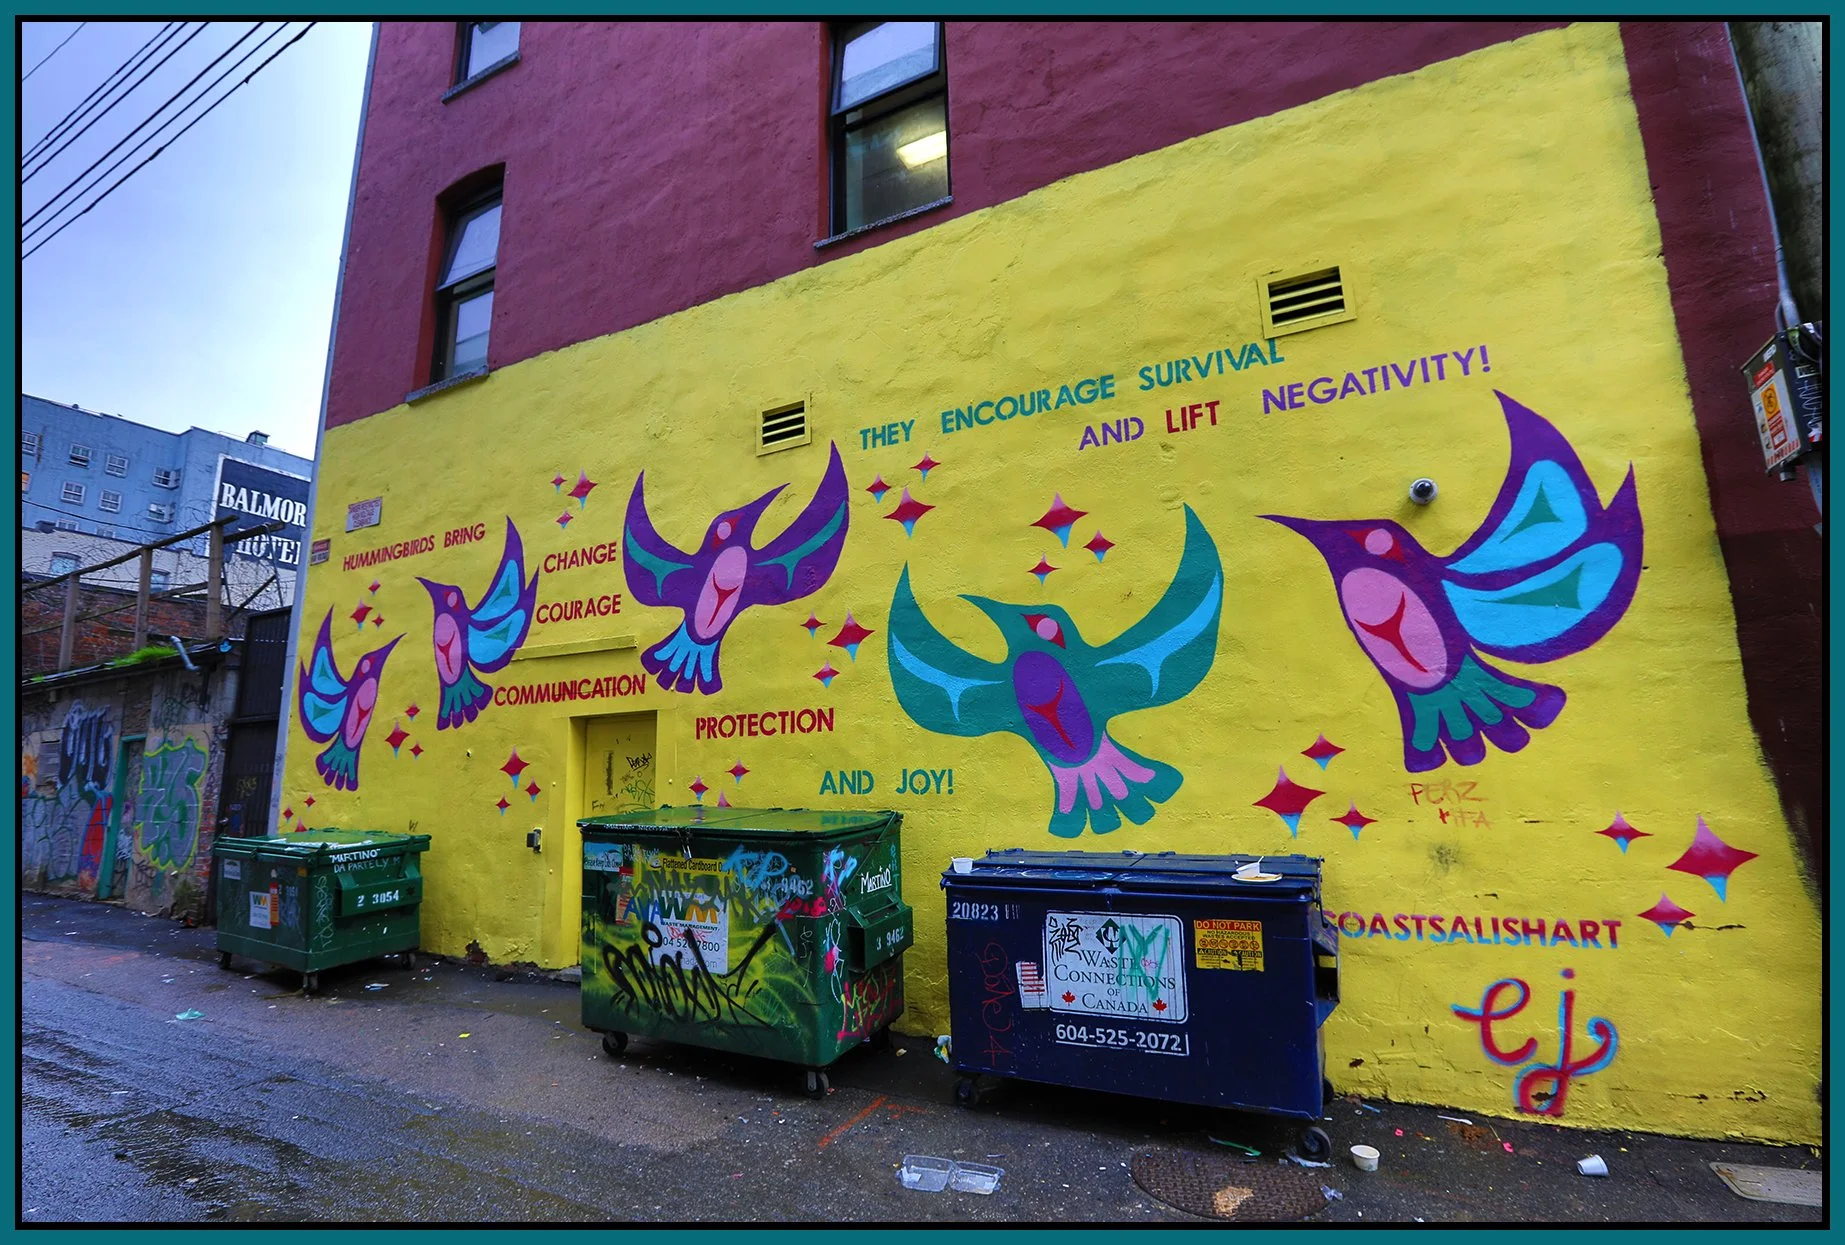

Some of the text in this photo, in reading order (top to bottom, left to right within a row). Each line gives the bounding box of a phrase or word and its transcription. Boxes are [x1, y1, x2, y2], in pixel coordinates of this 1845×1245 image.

[860, 338, 1284, 450] THEY ENCOURAGE SURVIVAL
[1079, 344, 1491, 451] AND LIFT NEGATIVITY!
[343, 535, 435, 571] HUMMINGBIRDS
[443, 523, 486, 549] BRING
[543, 541, 617, 573] CHANGE
[535, 594, 622, 625] COURAGE
[493, 674, 647, 707] COMMUNICATION
[695, 707, 835, 740] PROTECTION
[819, 767, 954, 796] AND JOY!
[662, 857, 688, 870] Flattened
[688, 858, 718, 873] Cardboard
[952, 901, 999, 921] 20823
[1196, 920, 1260, 931] DO NOT PARK
[1053, 964, 1176, 990] CONNECTIONS
[1082, 993, 1149, 1014] CANADA
[1107, 987, 1121, 997] OF
[1056, 1023, 1183, 1052] 604-525-2072
